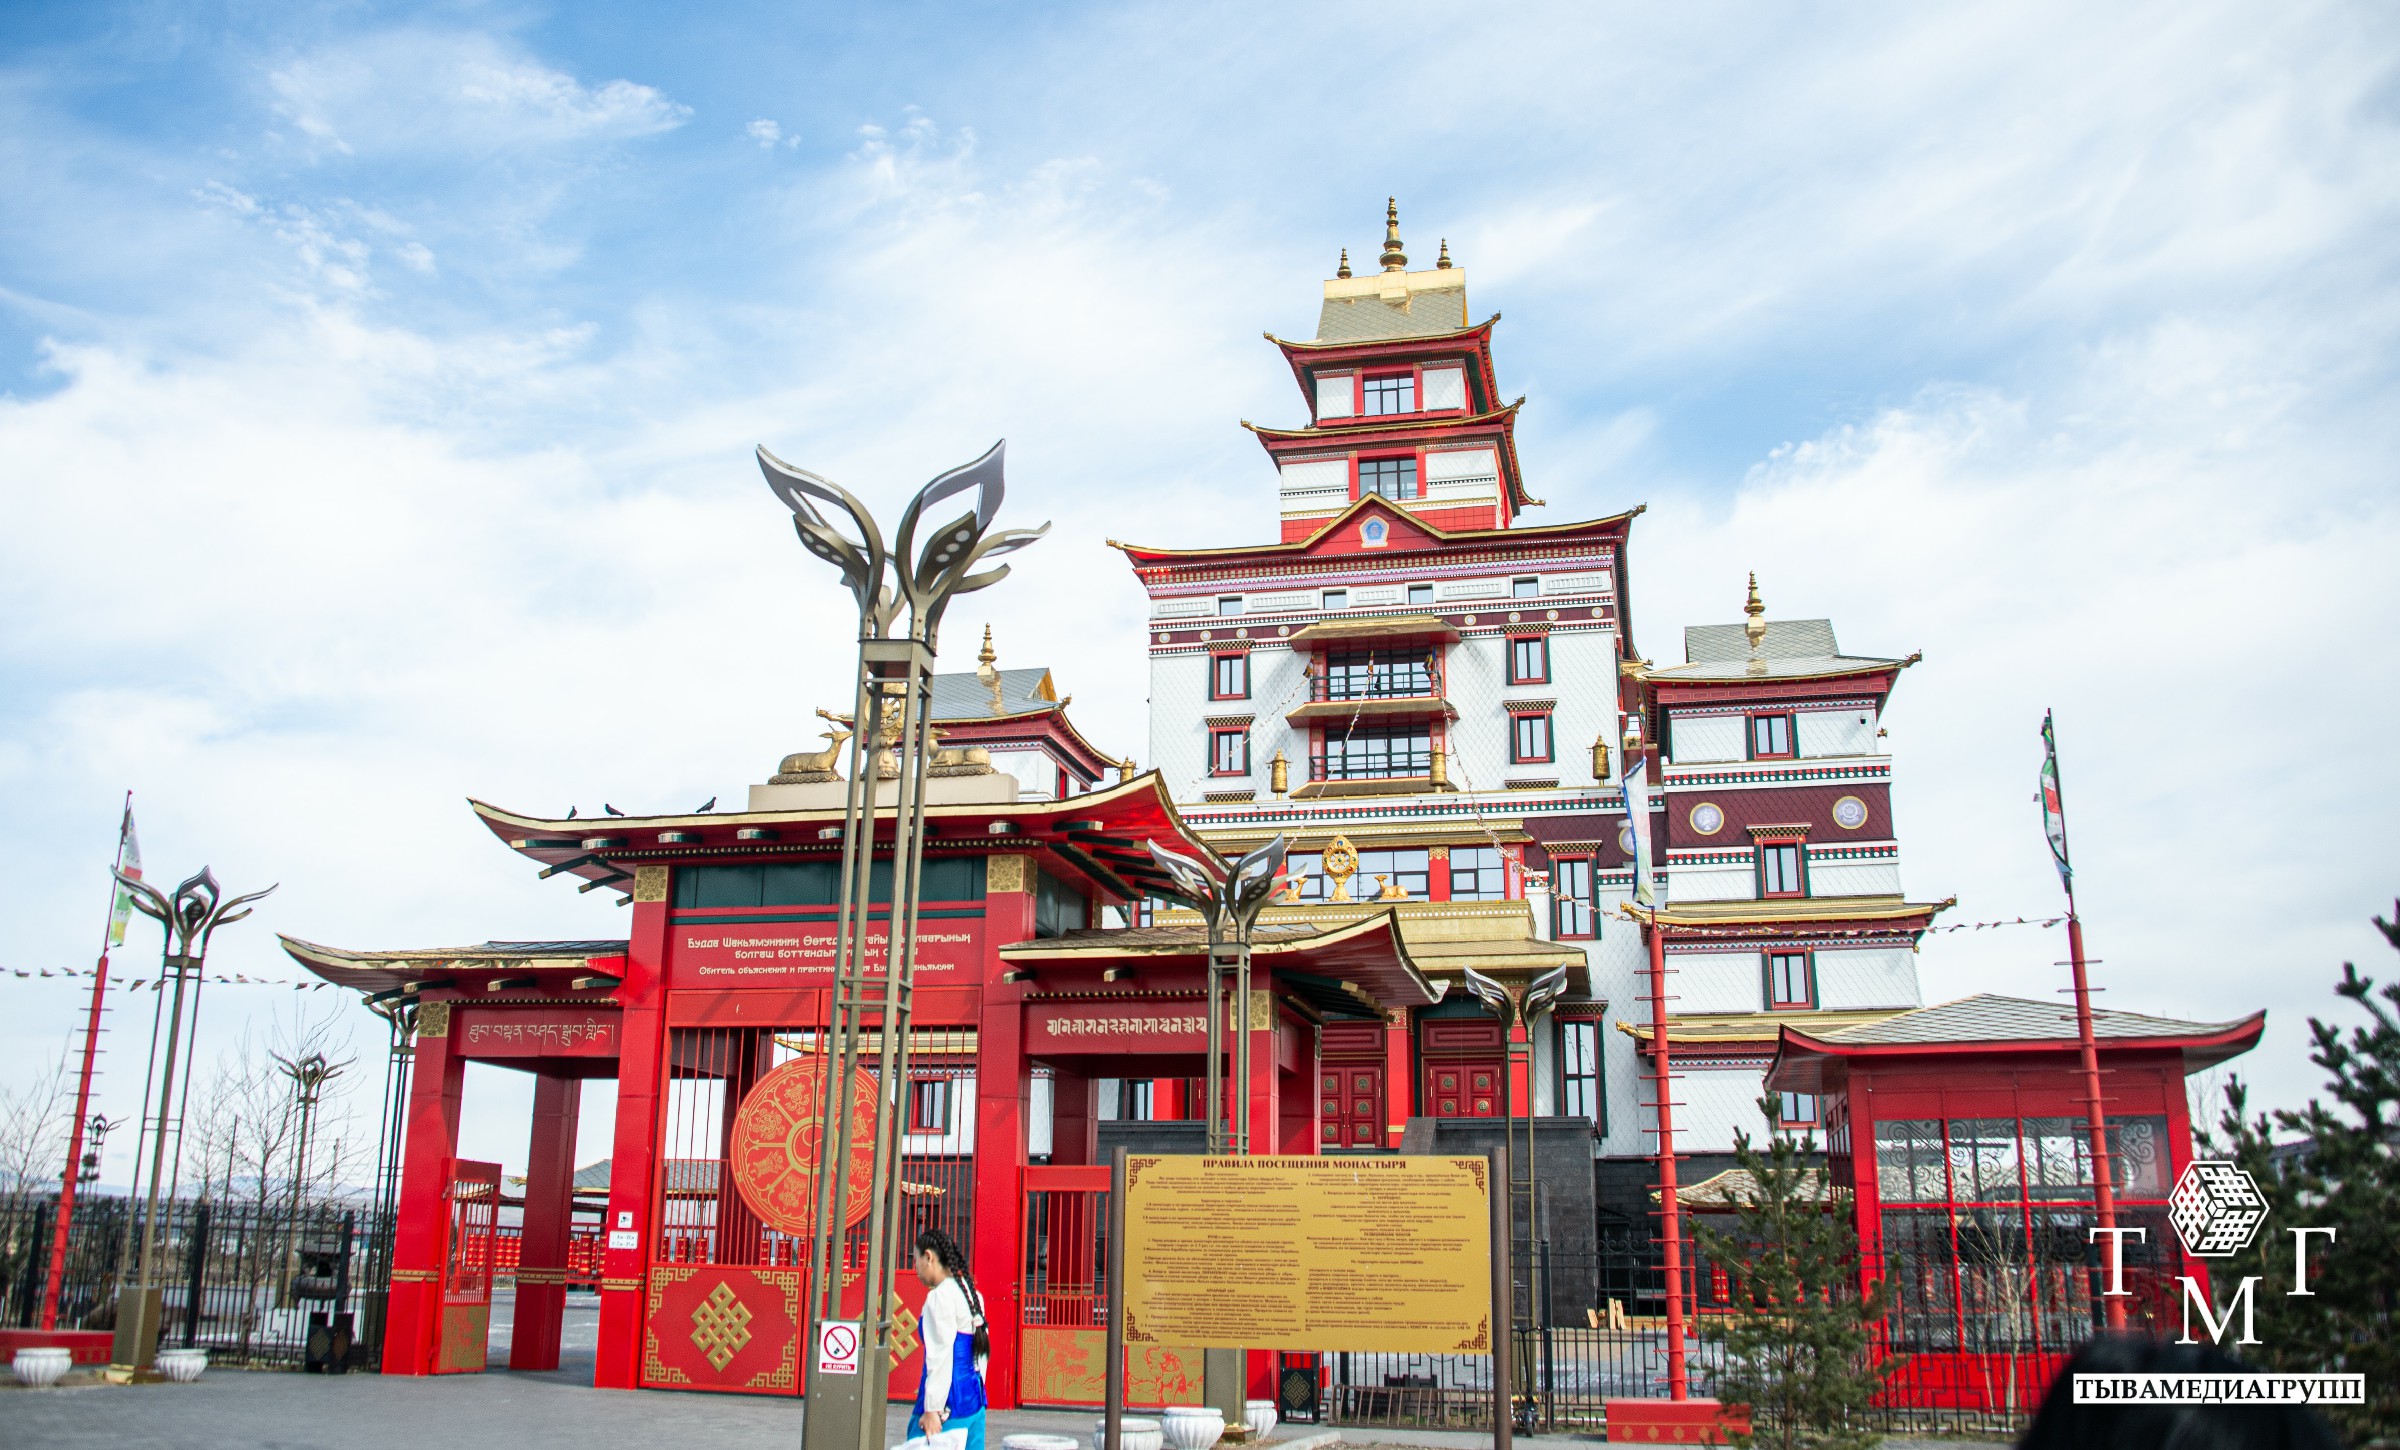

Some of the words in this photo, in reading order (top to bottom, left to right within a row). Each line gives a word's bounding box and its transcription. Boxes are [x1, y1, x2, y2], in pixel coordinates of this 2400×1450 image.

[687, 938, 719, 949] Будда
[735, 950, 774, 959] болгаш
[699, 966, 735, 975] Обитель
[737, 966, 787, 974] объяснения
[1202, 1159, 1255, 1169] ПРАВИЛА
[1257, 1159, 1330, 1170] ПОСЕЩЕНИЯ
[1332, 1160, 1407, 1170] МОНАСТЫРЯ
